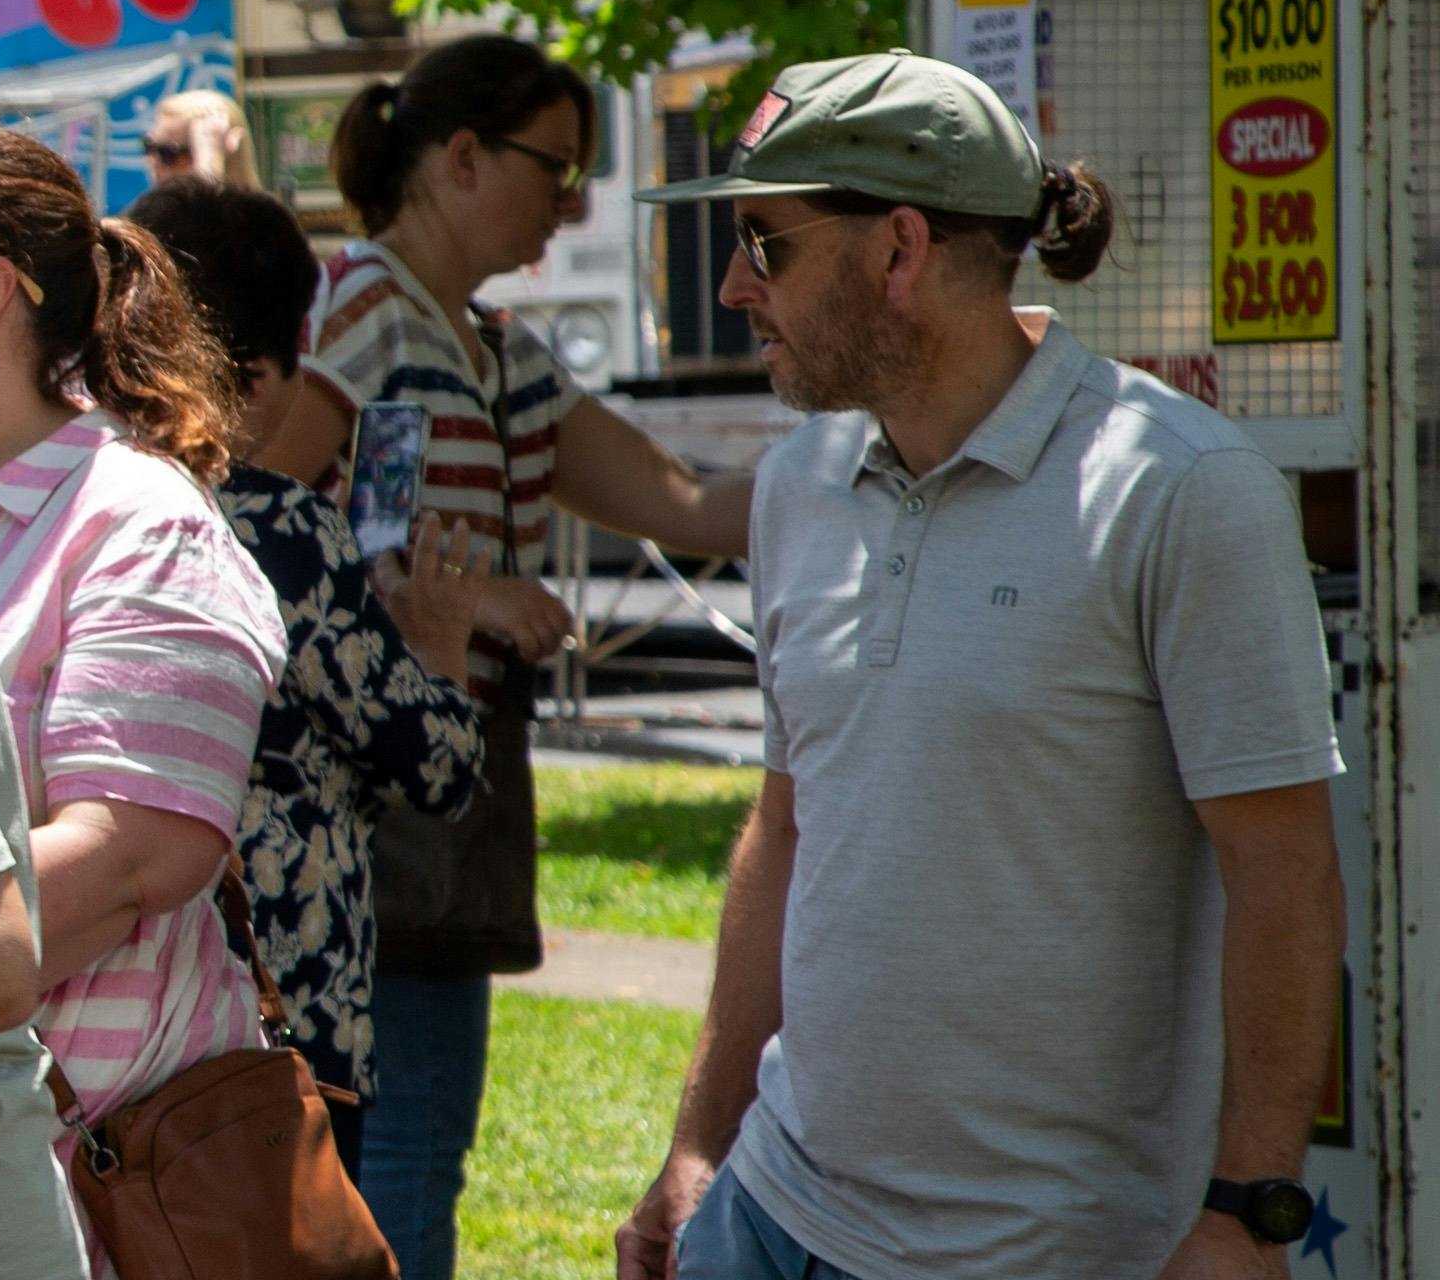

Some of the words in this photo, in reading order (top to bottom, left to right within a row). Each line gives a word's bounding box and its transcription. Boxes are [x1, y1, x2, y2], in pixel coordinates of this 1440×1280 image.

[1224, 67, 1252, 87] PER
[1258, 61, 1322, 84] PERSON
[1232, 114, 1314, 163] SPECIAL
[1231, 186, 1247, 249] 3
[1259, 190, 1317, 246] FOR
[1223, 254, 1328, 329] $25.00
